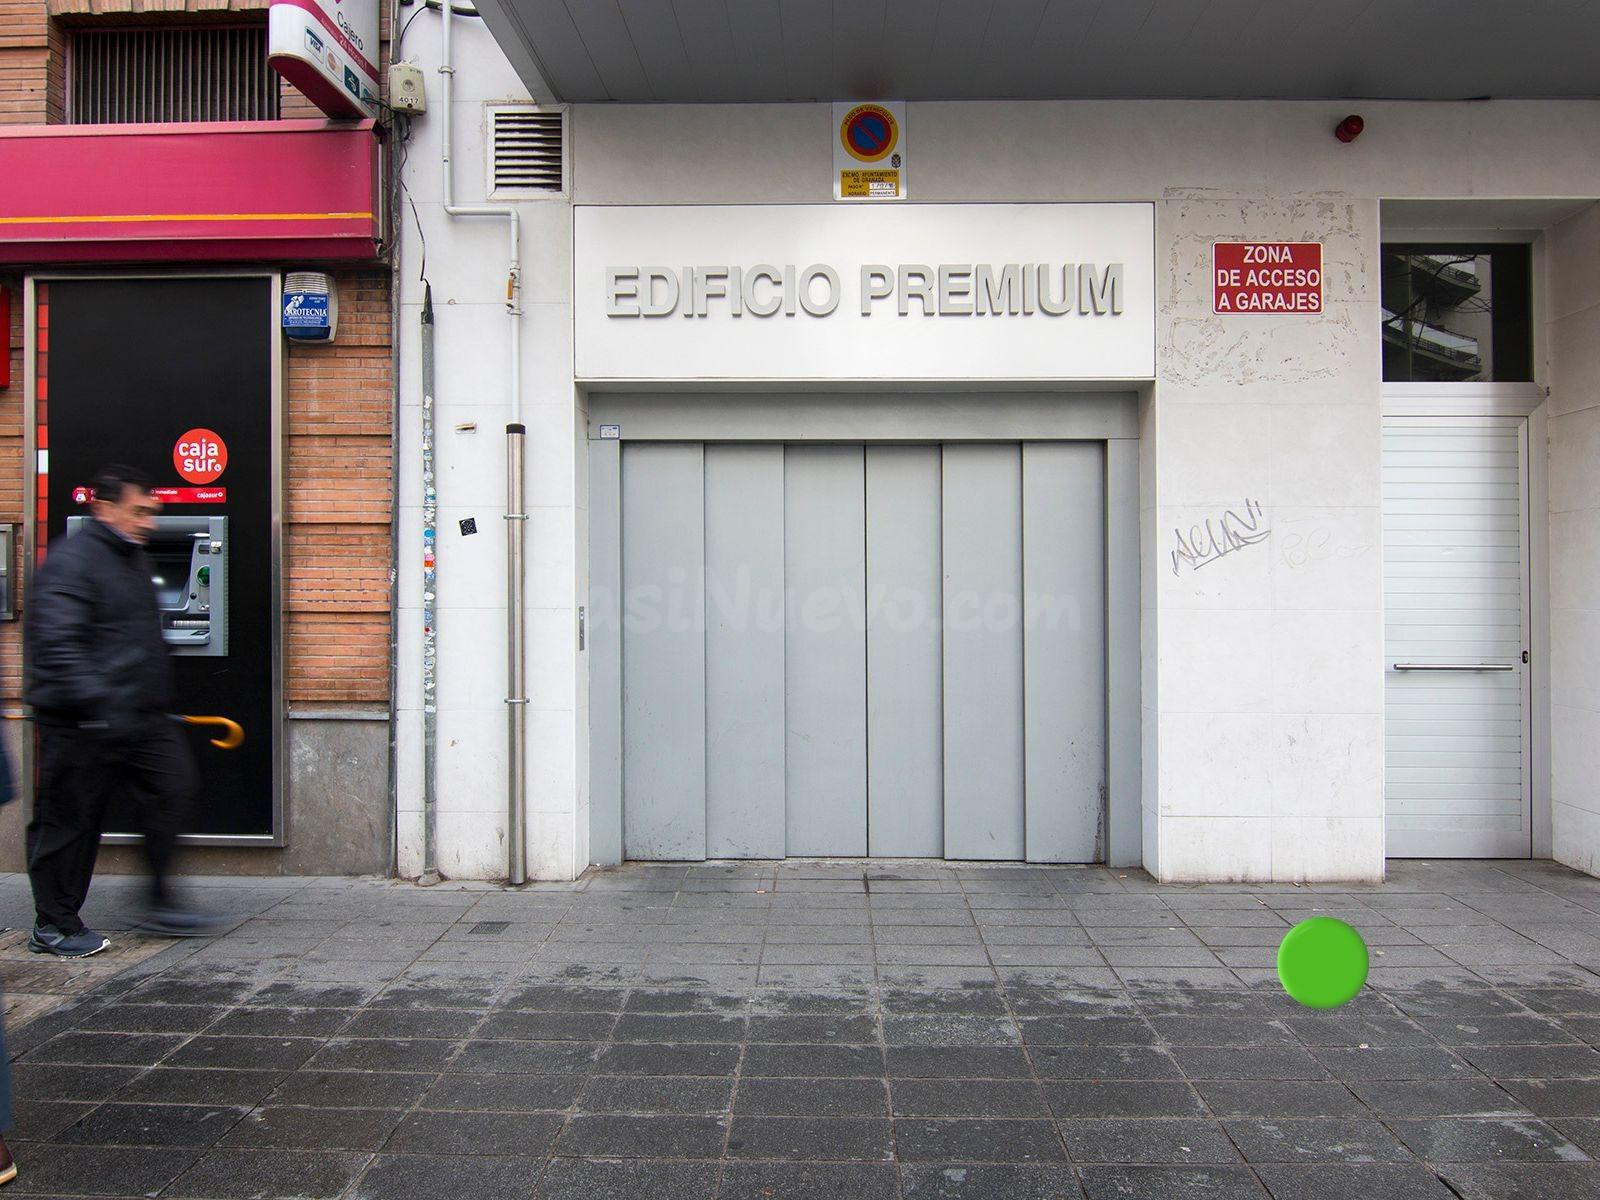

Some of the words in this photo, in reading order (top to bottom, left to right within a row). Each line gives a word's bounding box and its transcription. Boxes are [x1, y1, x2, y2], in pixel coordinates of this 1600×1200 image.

[337, 11, 364, 51] Cajero
[310, 37, 321, 53] VISA
[399, 96, 419, 105] 4017
[1243, 246, 1293, 264] ZONA
[1217, 269, 1241, 287] DE
[1245, 269, 1320, 287] ACCESO
[606, 263, 841, 318] EDIFICIO
[860, 263, 1124, 317] PREMIUM
[1218, 292, 1231, 310] A
[1235, 292, 1320, 310] GARAJES
[178, 438, 219, 460] caja
[196, 491, 218, 500] cajasur
